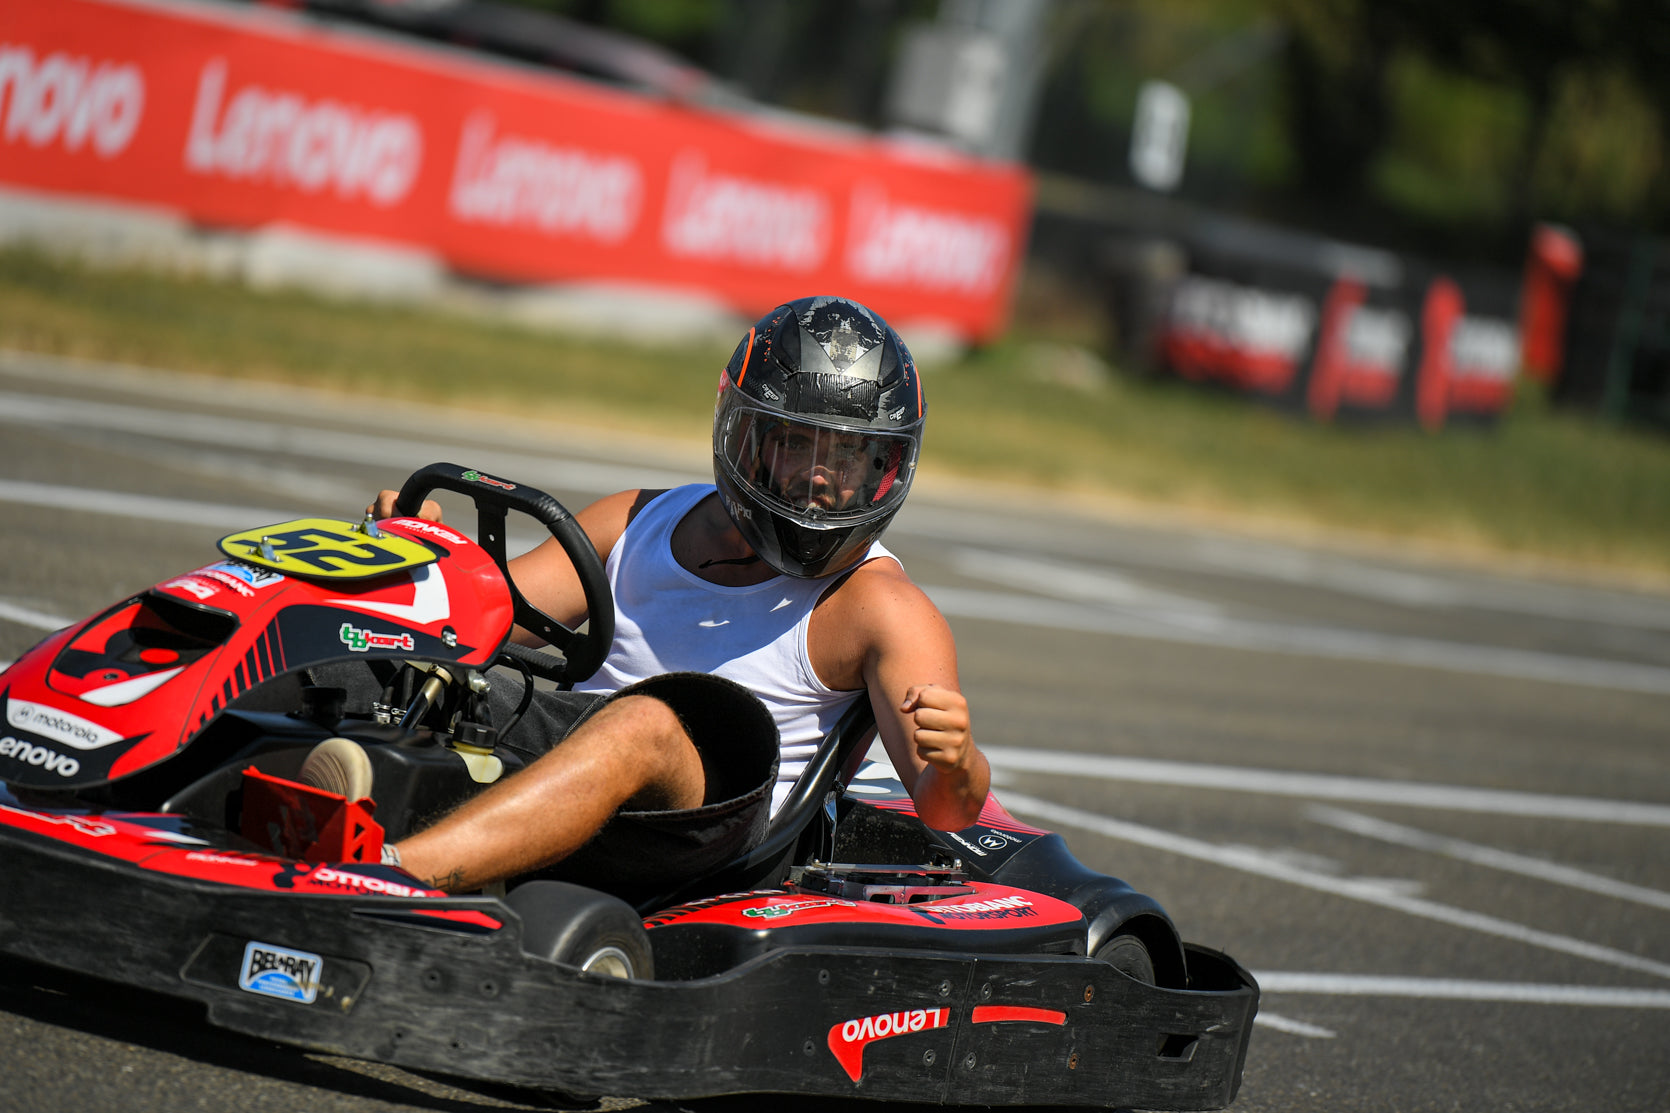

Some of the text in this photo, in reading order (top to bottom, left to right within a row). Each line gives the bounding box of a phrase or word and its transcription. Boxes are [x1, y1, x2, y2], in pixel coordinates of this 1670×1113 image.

[184, 56, 424, 207] Lenovo
[449, 109, 645, 246] Lenovo
[32, 711, 98, 744] motorola
[0, 736, 80, 777] enovo
[842, 1008, 941, 1042] Lenovo
